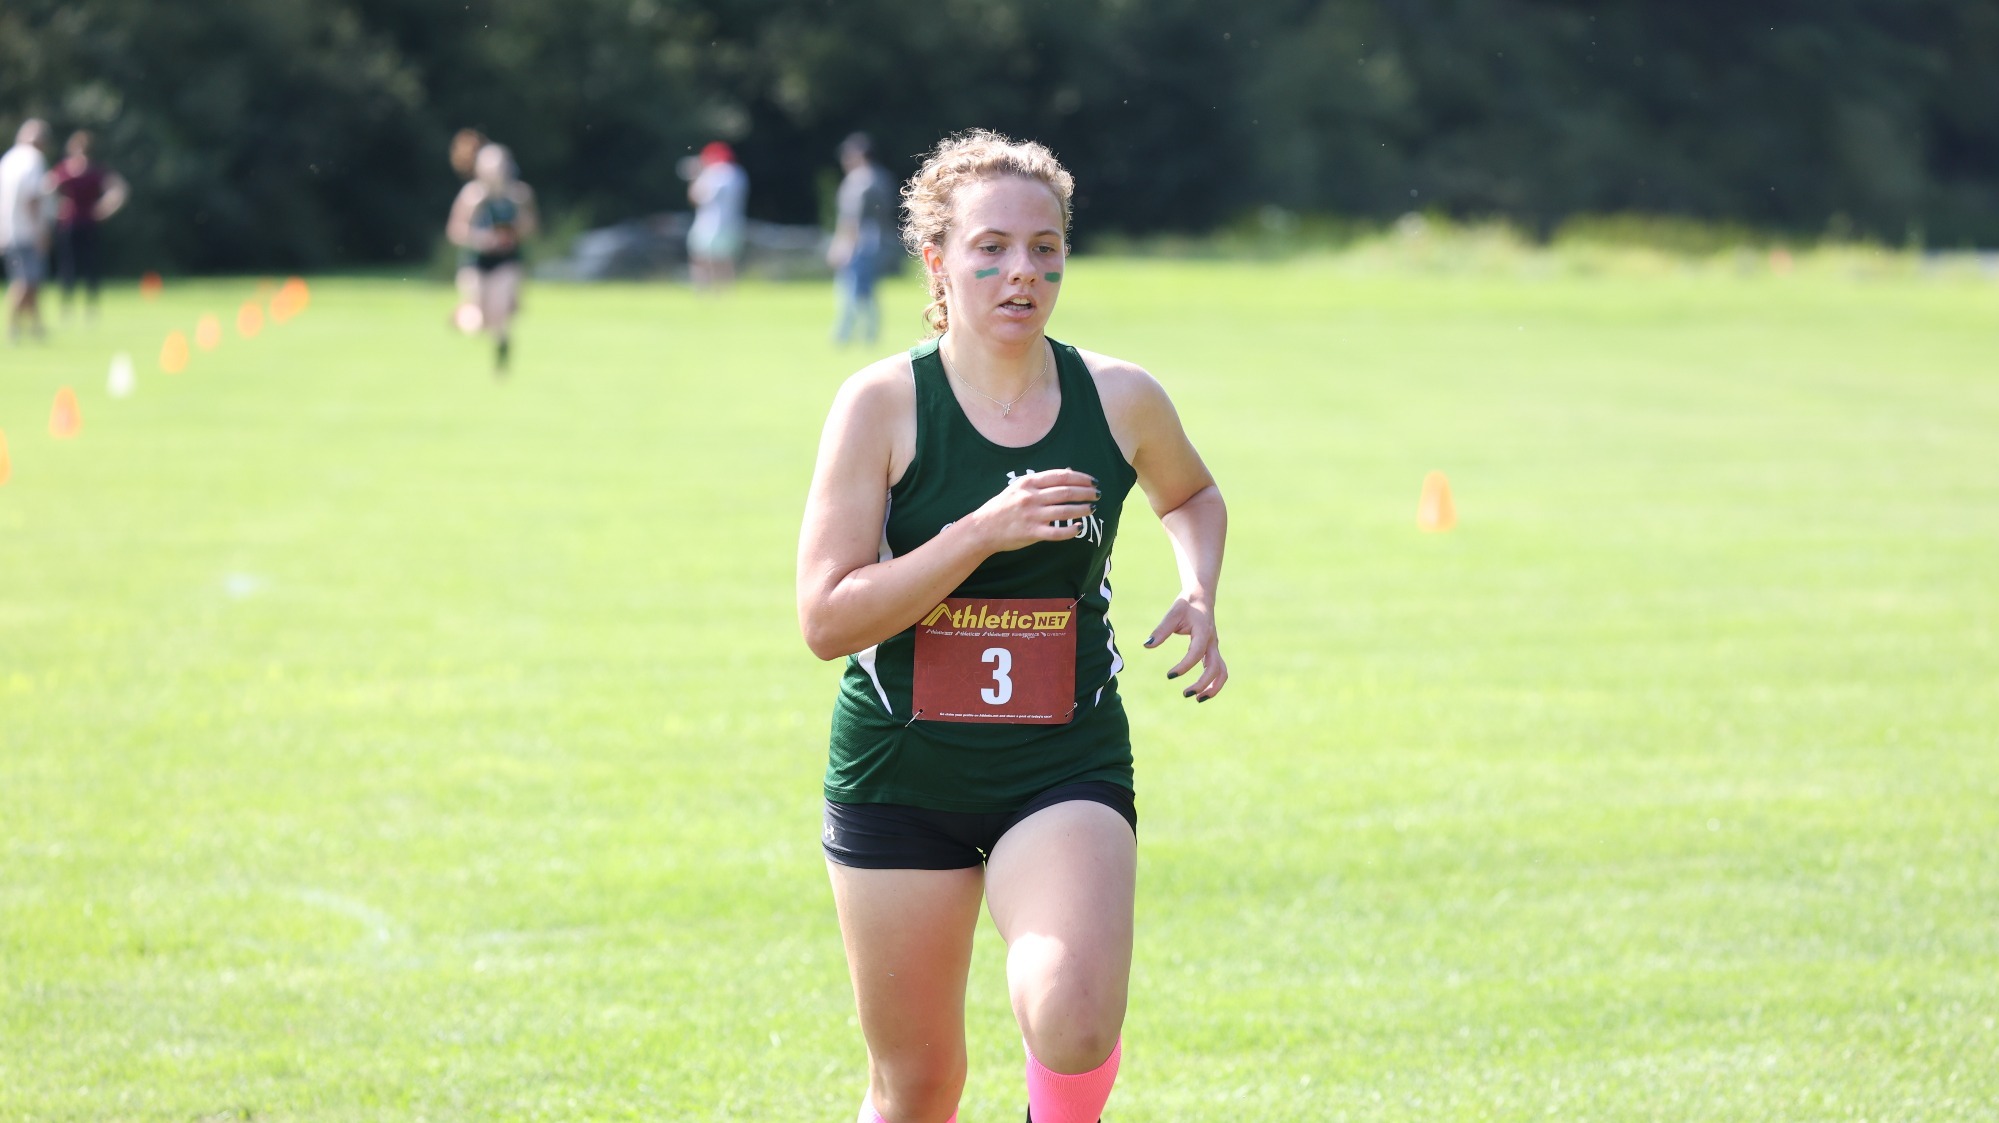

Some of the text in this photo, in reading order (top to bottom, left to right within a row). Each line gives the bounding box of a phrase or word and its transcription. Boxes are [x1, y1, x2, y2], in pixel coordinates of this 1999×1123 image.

[921, 602, 1066, 629] Athletic NET
[980, 647, 1013, 705] 3
